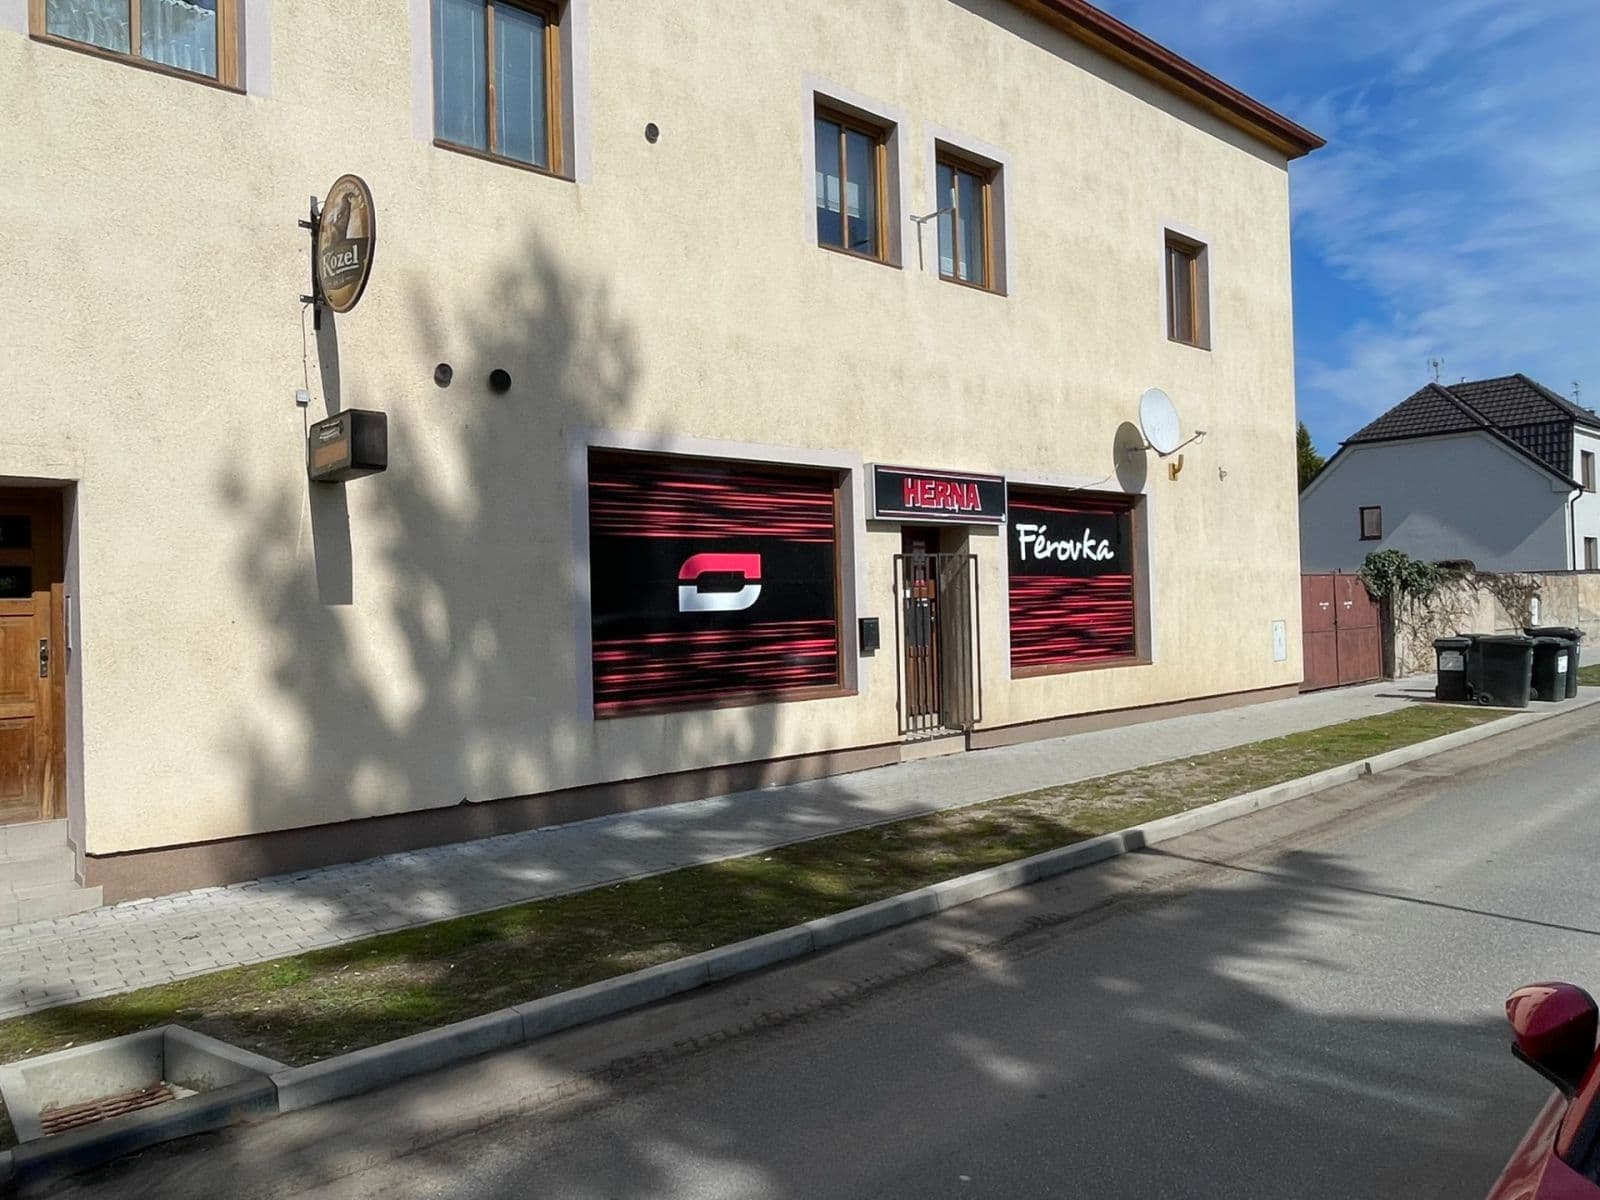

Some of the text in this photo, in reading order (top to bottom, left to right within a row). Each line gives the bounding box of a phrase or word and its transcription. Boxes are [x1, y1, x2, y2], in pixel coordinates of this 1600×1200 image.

[322, 244, 359, 278] Kozel
[903, 478, 982, 512] HERNA
[1015, 523, 1114, 561] Férovka
